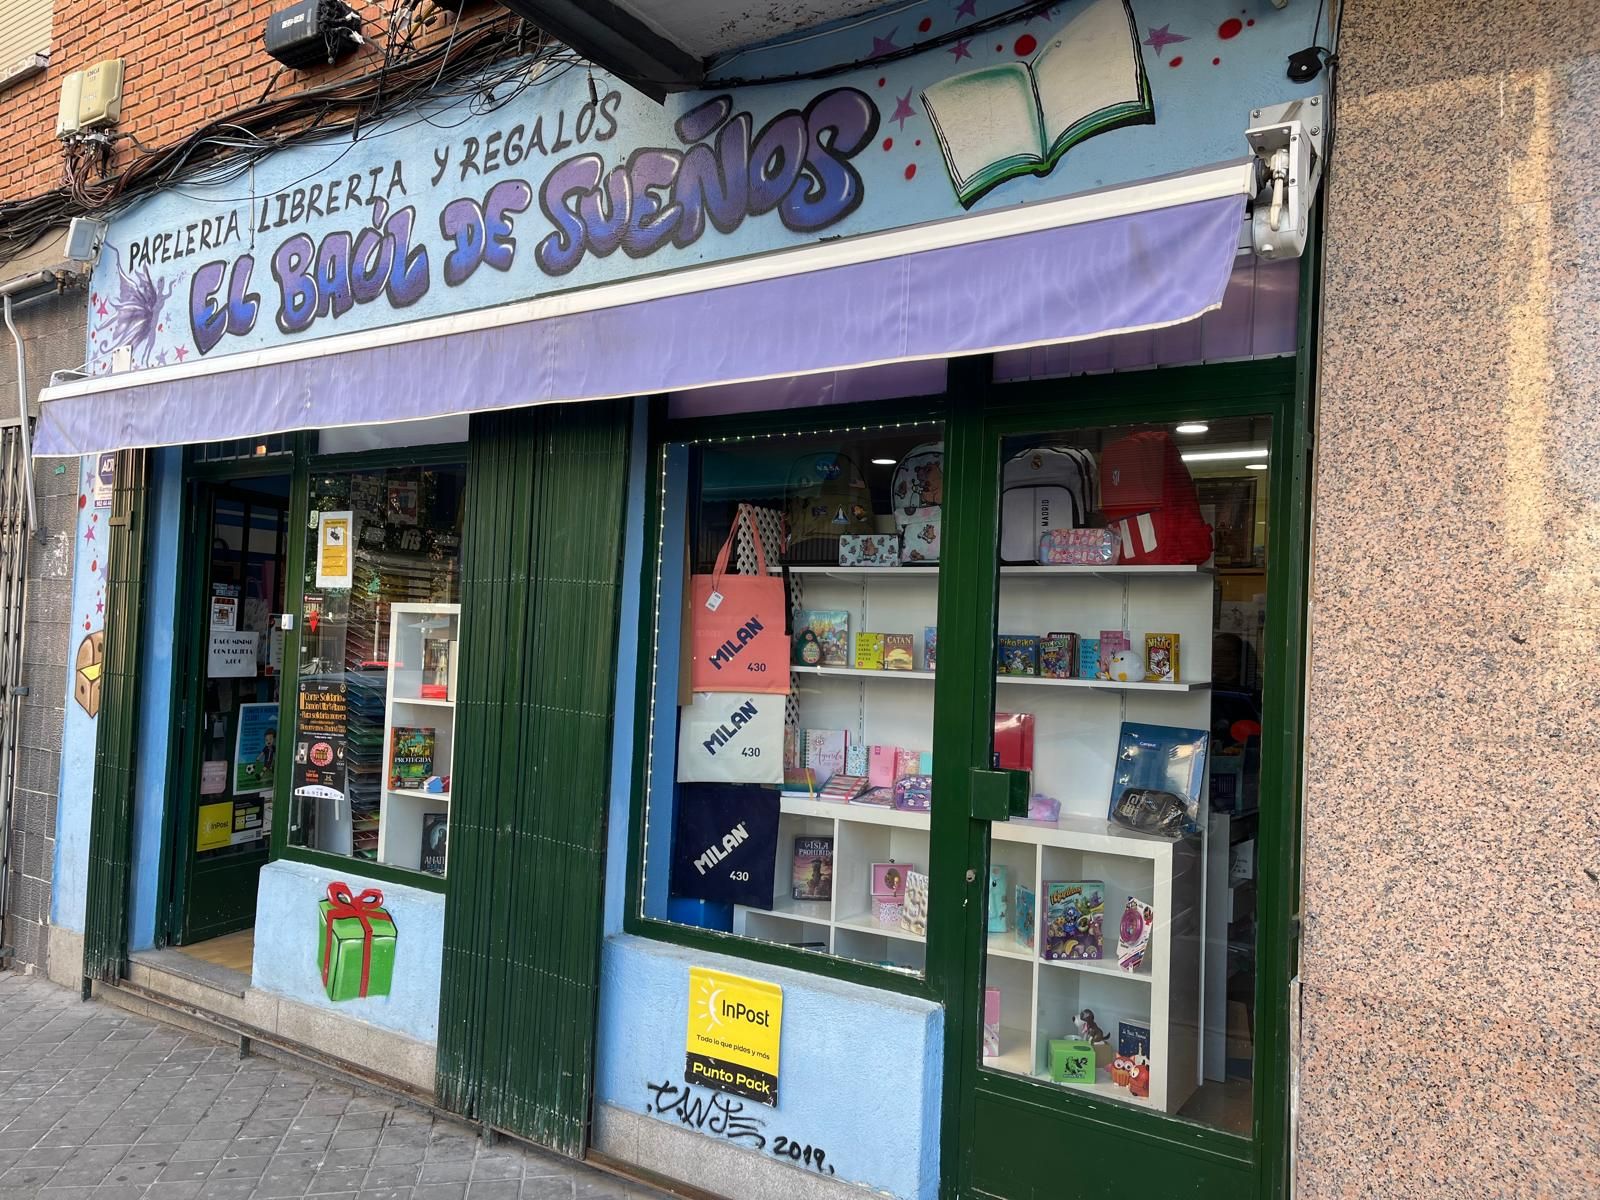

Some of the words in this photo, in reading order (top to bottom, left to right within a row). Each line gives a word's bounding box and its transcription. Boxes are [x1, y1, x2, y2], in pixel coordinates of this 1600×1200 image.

[129, 209, 241, 274] PAPELERIA
[431, 148, 449, 188] Y
[460, 90, 621, 179] REGALOS
[188, 253, 260, 356] EL
[443, 178, 532, 288] DE
[535, 86, 881, 277] SUEÑOS
[816, 464, 841, 473] NASA
[1040, 499, 1050, 527] MADRID
[708, 616, 765, 671] MILAN
[887, 635, 912, 645] CATAN
[746, 662, 767, 673] 430
[702, 700, 759, 756] MILAN
[741, 746, 761, 758] 430
[693, 823, 750, 876] MILAN
[729, 870, 750, 882] 430
[722, 999, 770, 1028] InPost
[696, 1034, 713, 1044] Todo
[713, 1038, 720, 1046] lo
[720, 1041, 733, 1050] que
[733, 1043, 751, 1054] pides
[756, 1050, 770, 1060] más
[692, 1061, 734, 1083] Punto
[735, 1073, 771, 1095] Pack
